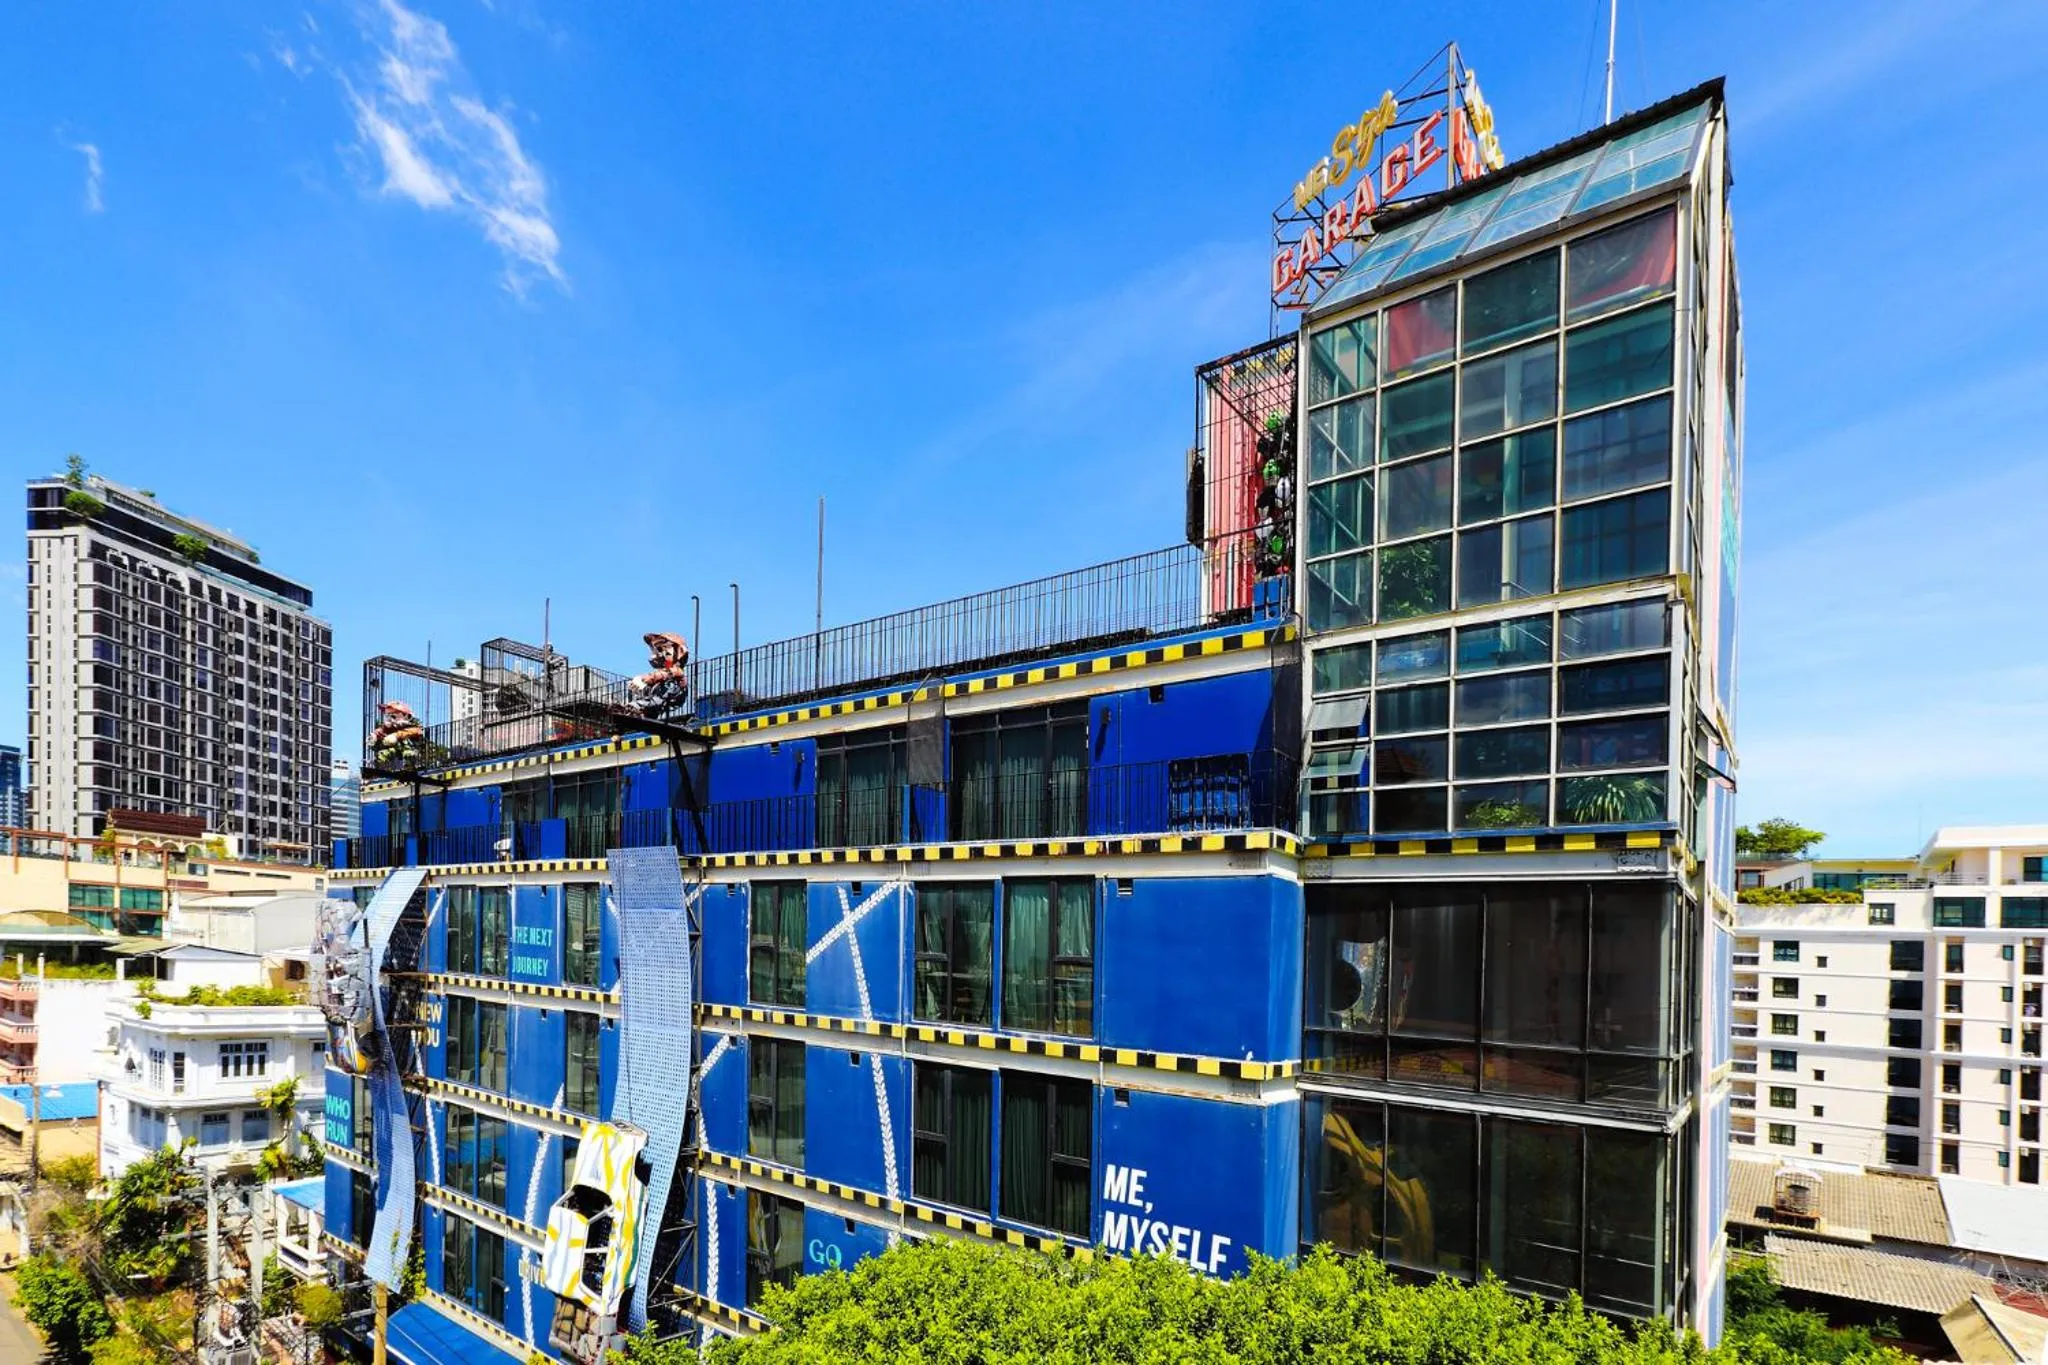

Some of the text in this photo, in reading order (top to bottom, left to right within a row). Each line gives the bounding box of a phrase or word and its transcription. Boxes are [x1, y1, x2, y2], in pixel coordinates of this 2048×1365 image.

[1273, 110, 1443, 295] GARAGE
[512, 926, 553, 948] THE NEXT
[511, 956, 549, 977] JOURNEY
[325, 1094, 350, 1121] WHO
[326, 1119, 348, 1146] RUN
[1103, 1163, 1153, 1214] ME,
[1102, 1210, 1231, 1274] MYSELF
